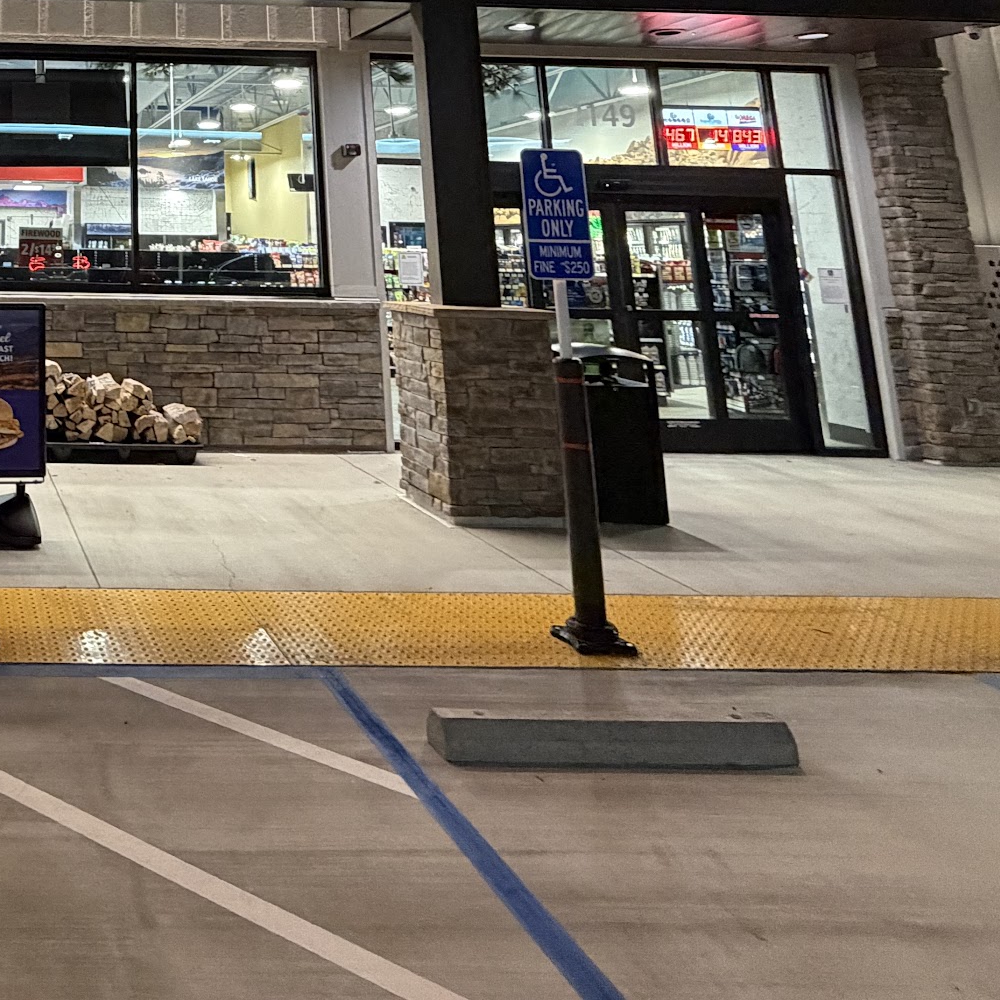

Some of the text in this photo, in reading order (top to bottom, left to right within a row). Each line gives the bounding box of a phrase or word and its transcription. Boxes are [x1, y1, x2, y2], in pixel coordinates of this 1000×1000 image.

[665, 127, 695, 142] 467
[732, 129, 762, 144] 843
[527, 198, 585, 218] PARKING
[21, 229, 61, 238] FIREWOOD
[541, 218, 574, 238] ONLY
[538, 245, 582, 258] MINIMUM
[533, 260, 591, 275] FINE $250
